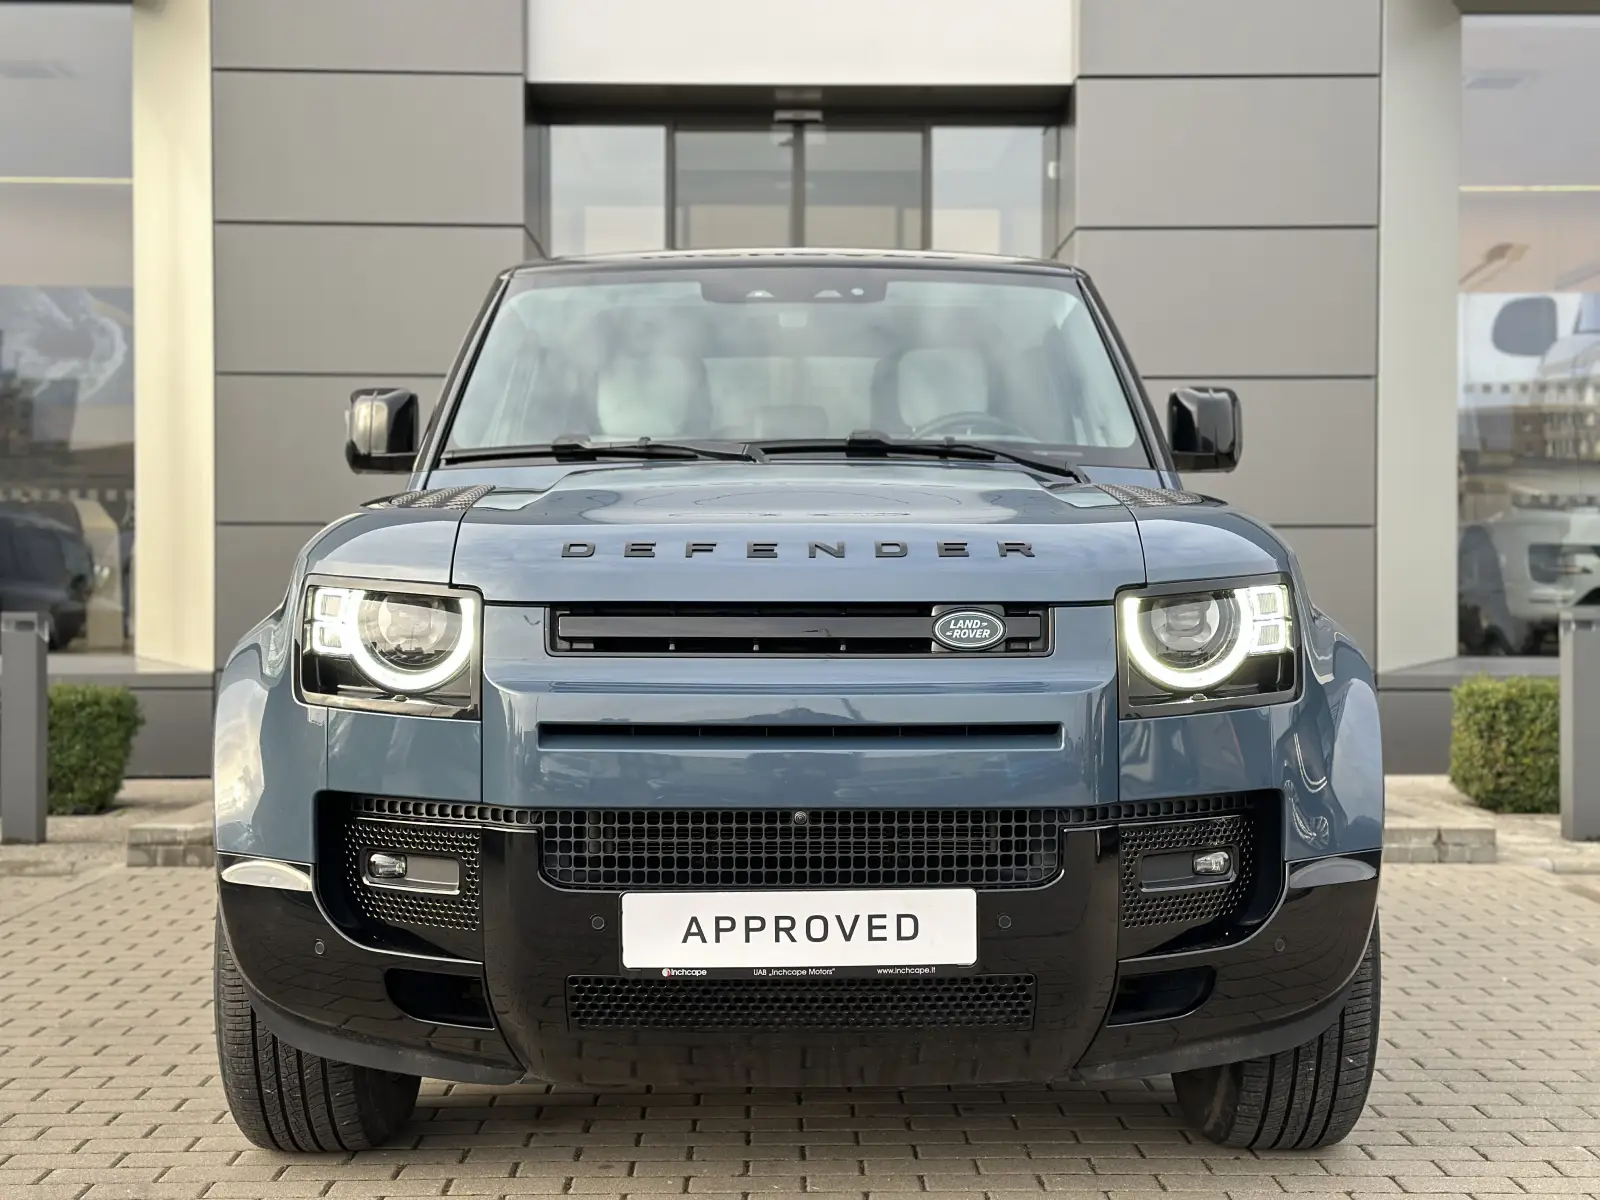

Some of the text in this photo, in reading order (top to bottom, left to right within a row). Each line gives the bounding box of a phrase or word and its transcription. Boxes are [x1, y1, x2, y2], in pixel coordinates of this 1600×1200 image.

[560, 540, 1037, 559] DEFENDER
[681, 913, 920, 944] APPROVED
[753, 968, 767, 976] UAB
[876, 966, 936, 975] www.inchcape.lt
